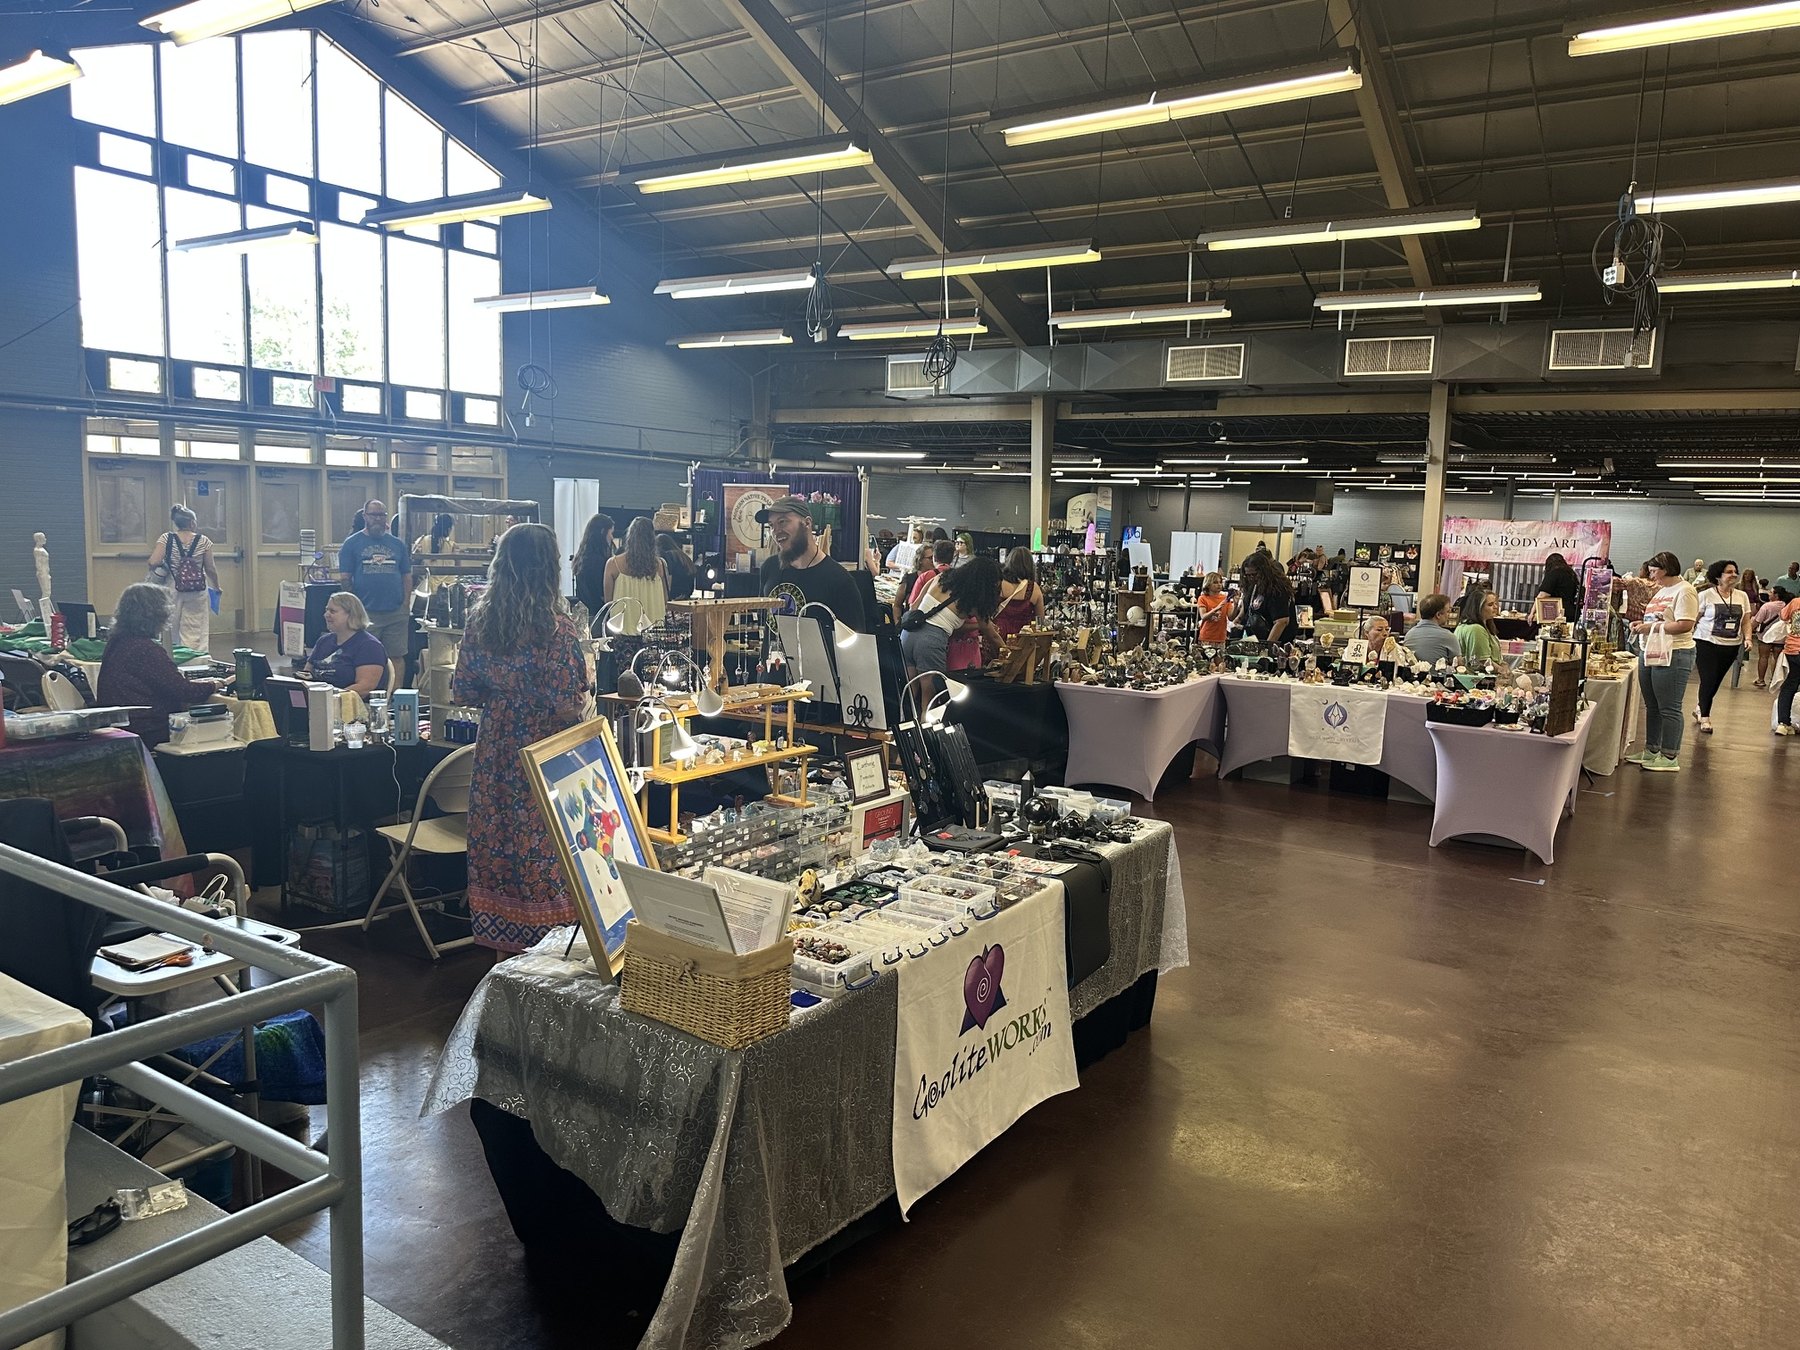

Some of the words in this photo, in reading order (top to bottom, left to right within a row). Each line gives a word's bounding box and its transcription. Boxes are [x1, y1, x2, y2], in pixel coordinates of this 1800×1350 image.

[1442, 532, 1493, 547] HENNA
[1499, 535, 1541, 549] BODY
[1549, 537, 1580, 550] ART
